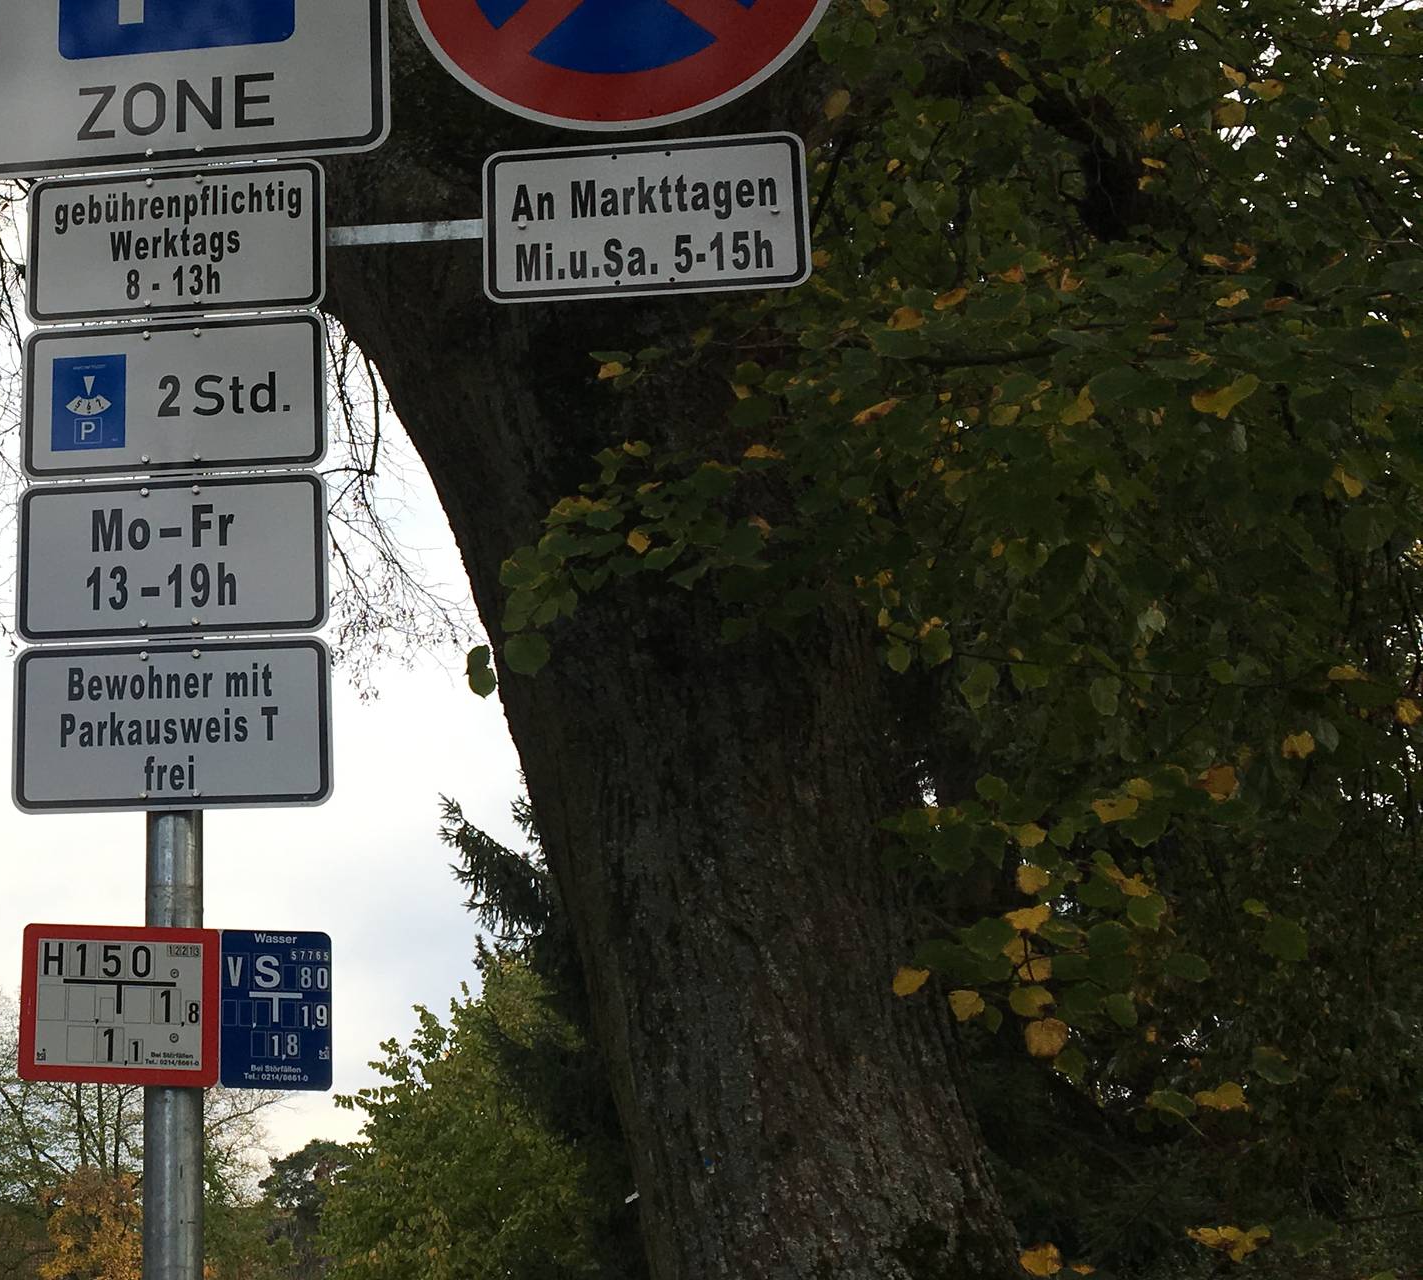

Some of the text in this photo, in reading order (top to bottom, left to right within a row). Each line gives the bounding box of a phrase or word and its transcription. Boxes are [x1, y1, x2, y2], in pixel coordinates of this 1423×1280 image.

[77, 72, 275, 141] ZONE
[54, 181, 302, 234] gebührenpflichtig
[511, 175, 777, 222] An Markttagen
[110, 227, 241, 263] Werktags
[515, 230, 774, 282] Mi.u.Sa. 5-15h
[126, 270, 141, 300] 8
[172, 264, 221, 296] 13h
[157, 371, 291, 417] 2 Std.
[81, 421, 96, 440] P
[68, 663, 273, 701] Bewohner mit
[60, 706, 278, 748] Parkausweis T
[144, 755, 195, 791] frei
[254, 933, 298, 944] Wasser
[264, 1065, 302, 1073] Störfällen
